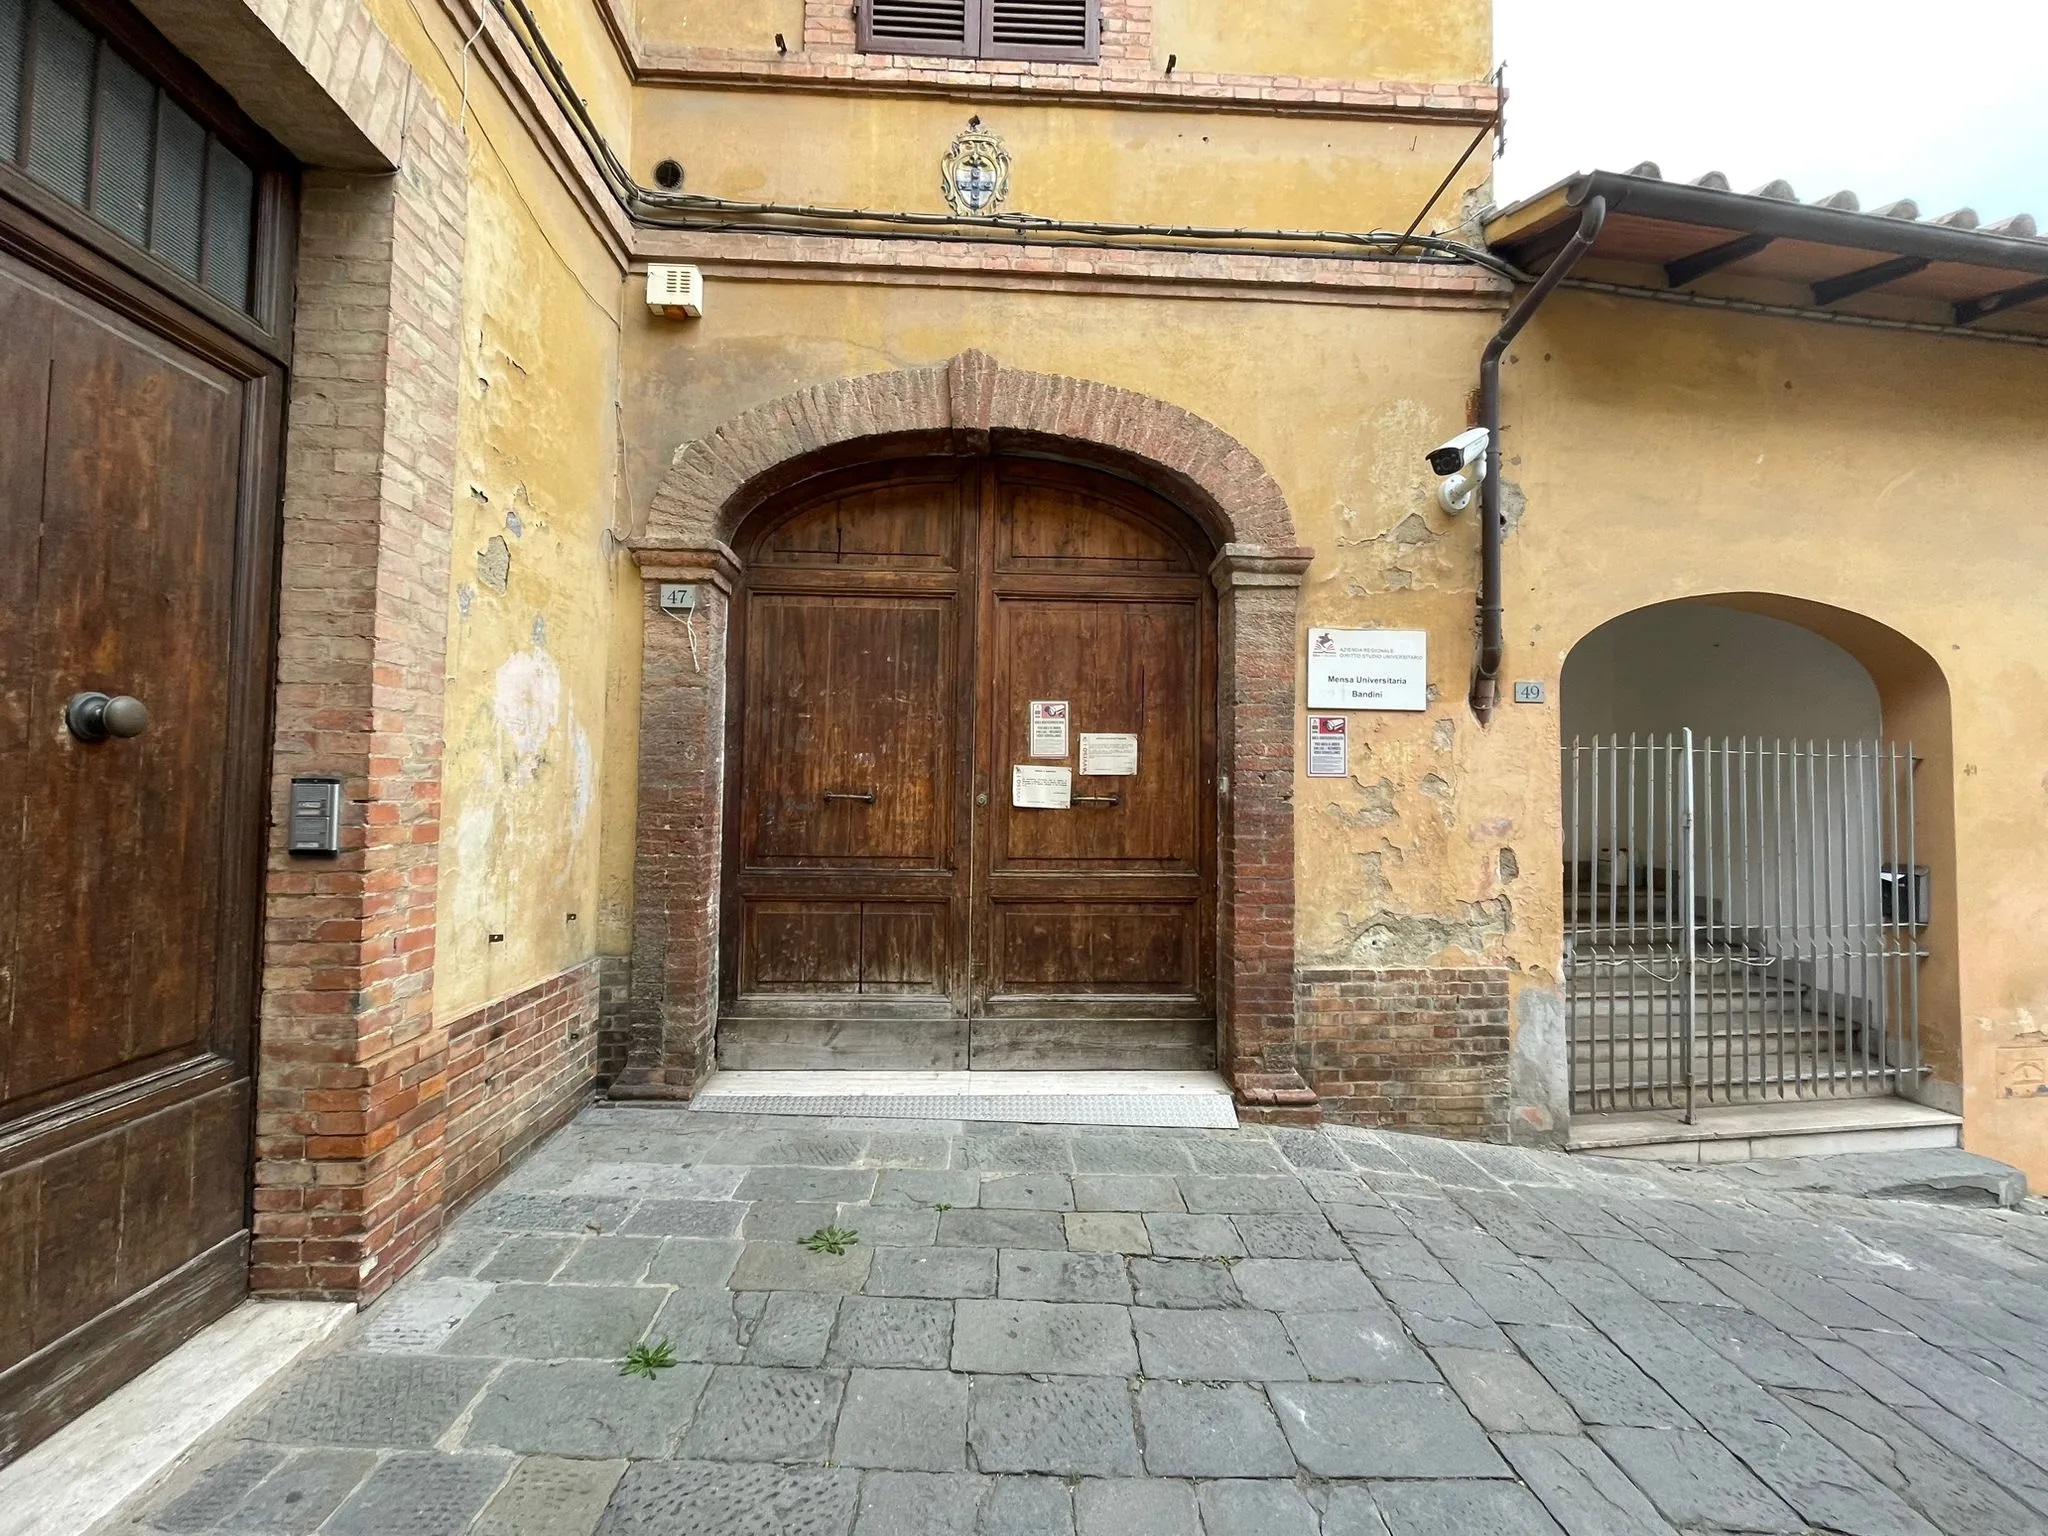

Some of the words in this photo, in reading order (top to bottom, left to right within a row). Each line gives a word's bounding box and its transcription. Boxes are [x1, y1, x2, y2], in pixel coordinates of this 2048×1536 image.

[667, 589, 687, 604] 47
[1327, 675, 1354, 683] Mensa
[1356, 676, 1407, 685] Universitaria
[1351, 690, 1383, 698] Bandini
[1520, 685, 1540, 699] 49
